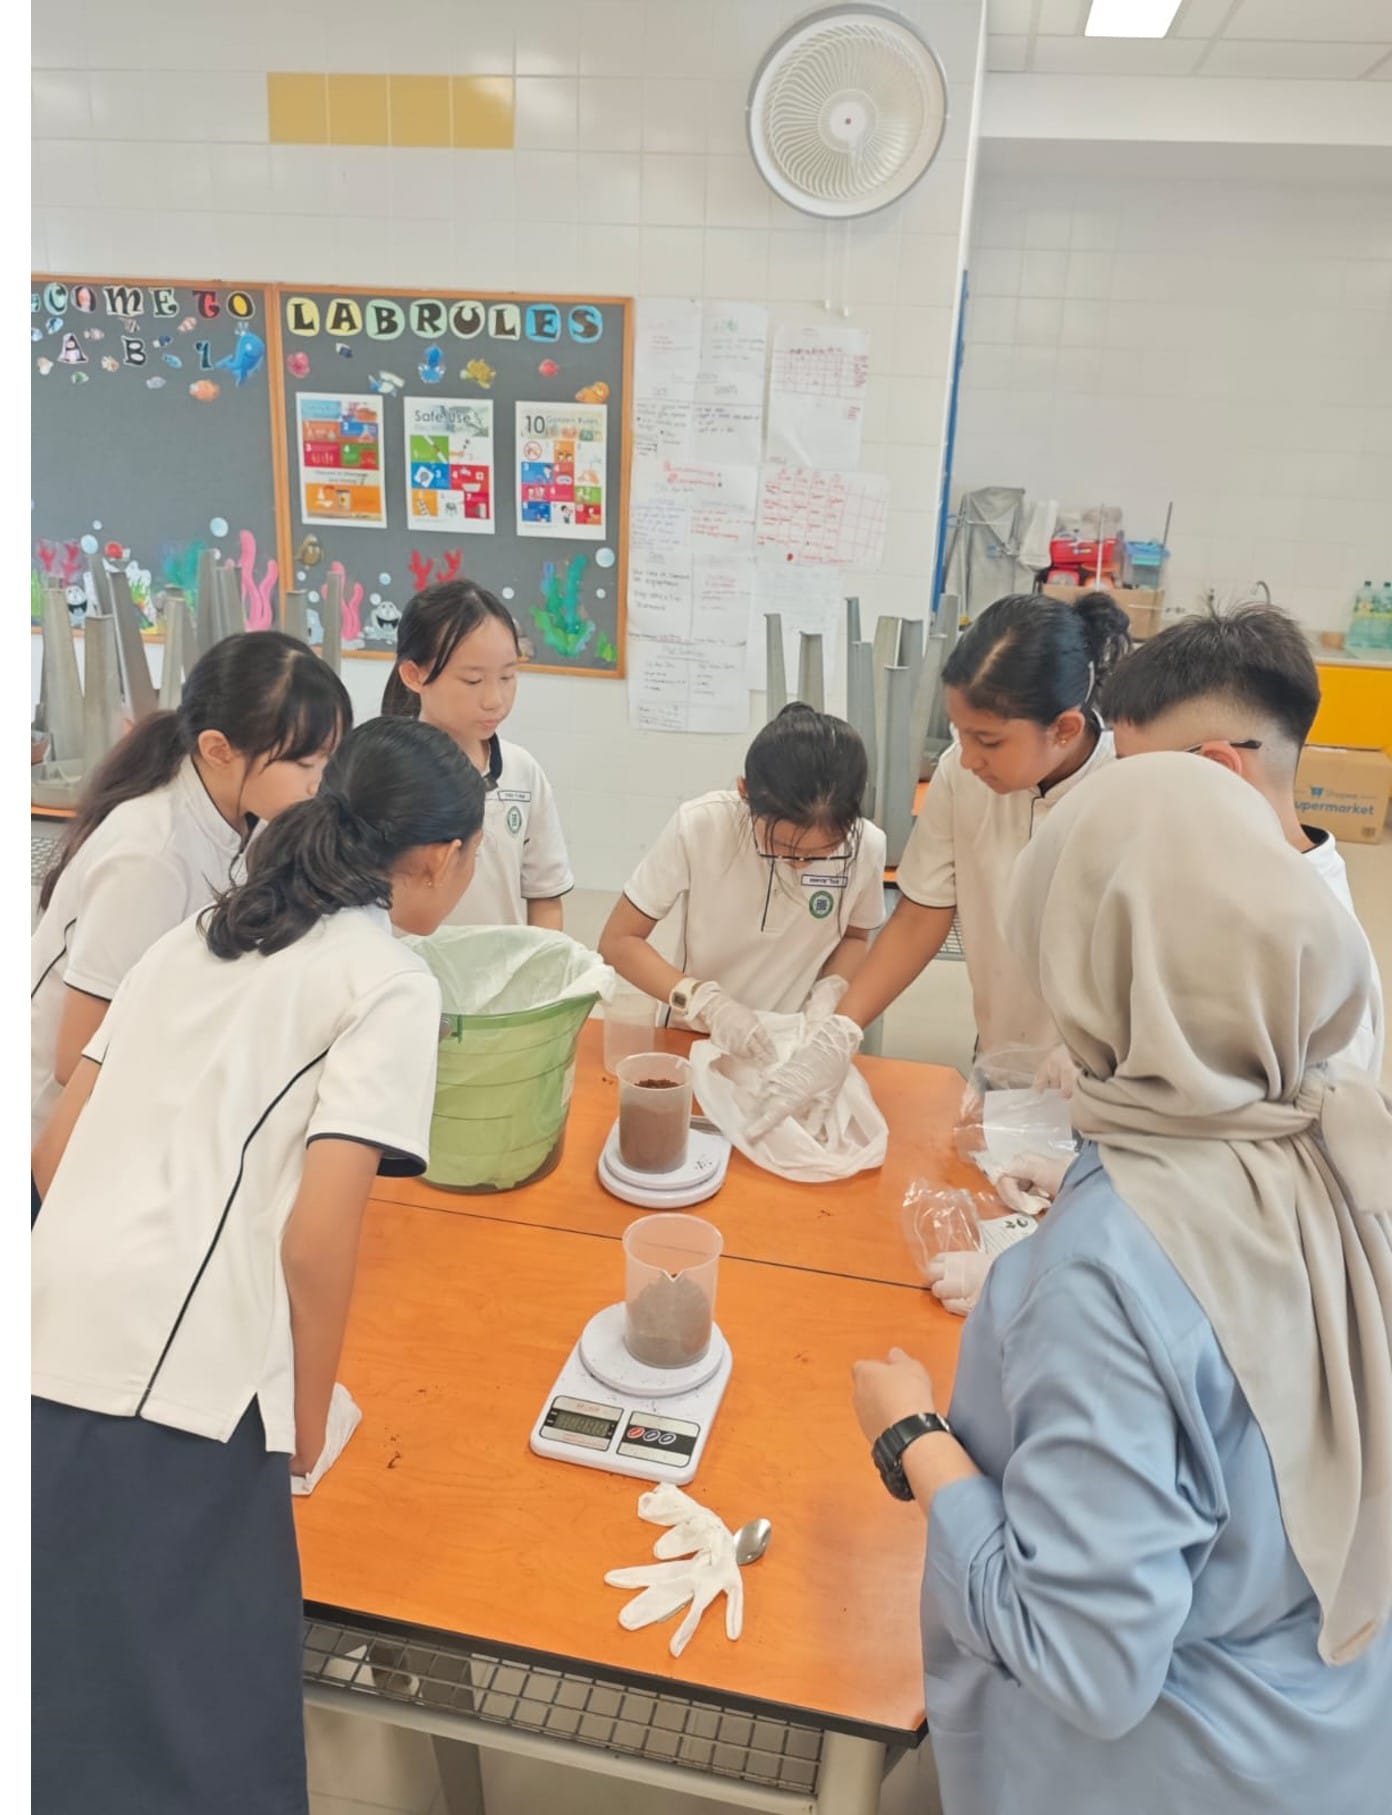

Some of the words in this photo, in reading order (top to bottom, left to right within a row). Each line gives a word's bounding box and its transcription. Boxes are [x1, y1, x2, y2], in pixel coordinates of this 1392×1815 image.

[31, 283, 179, 317] COME
[192, 289, 256, 320] TO
[415, 408, 445, 423] Safe
[525, 415, 546, 434] 10
